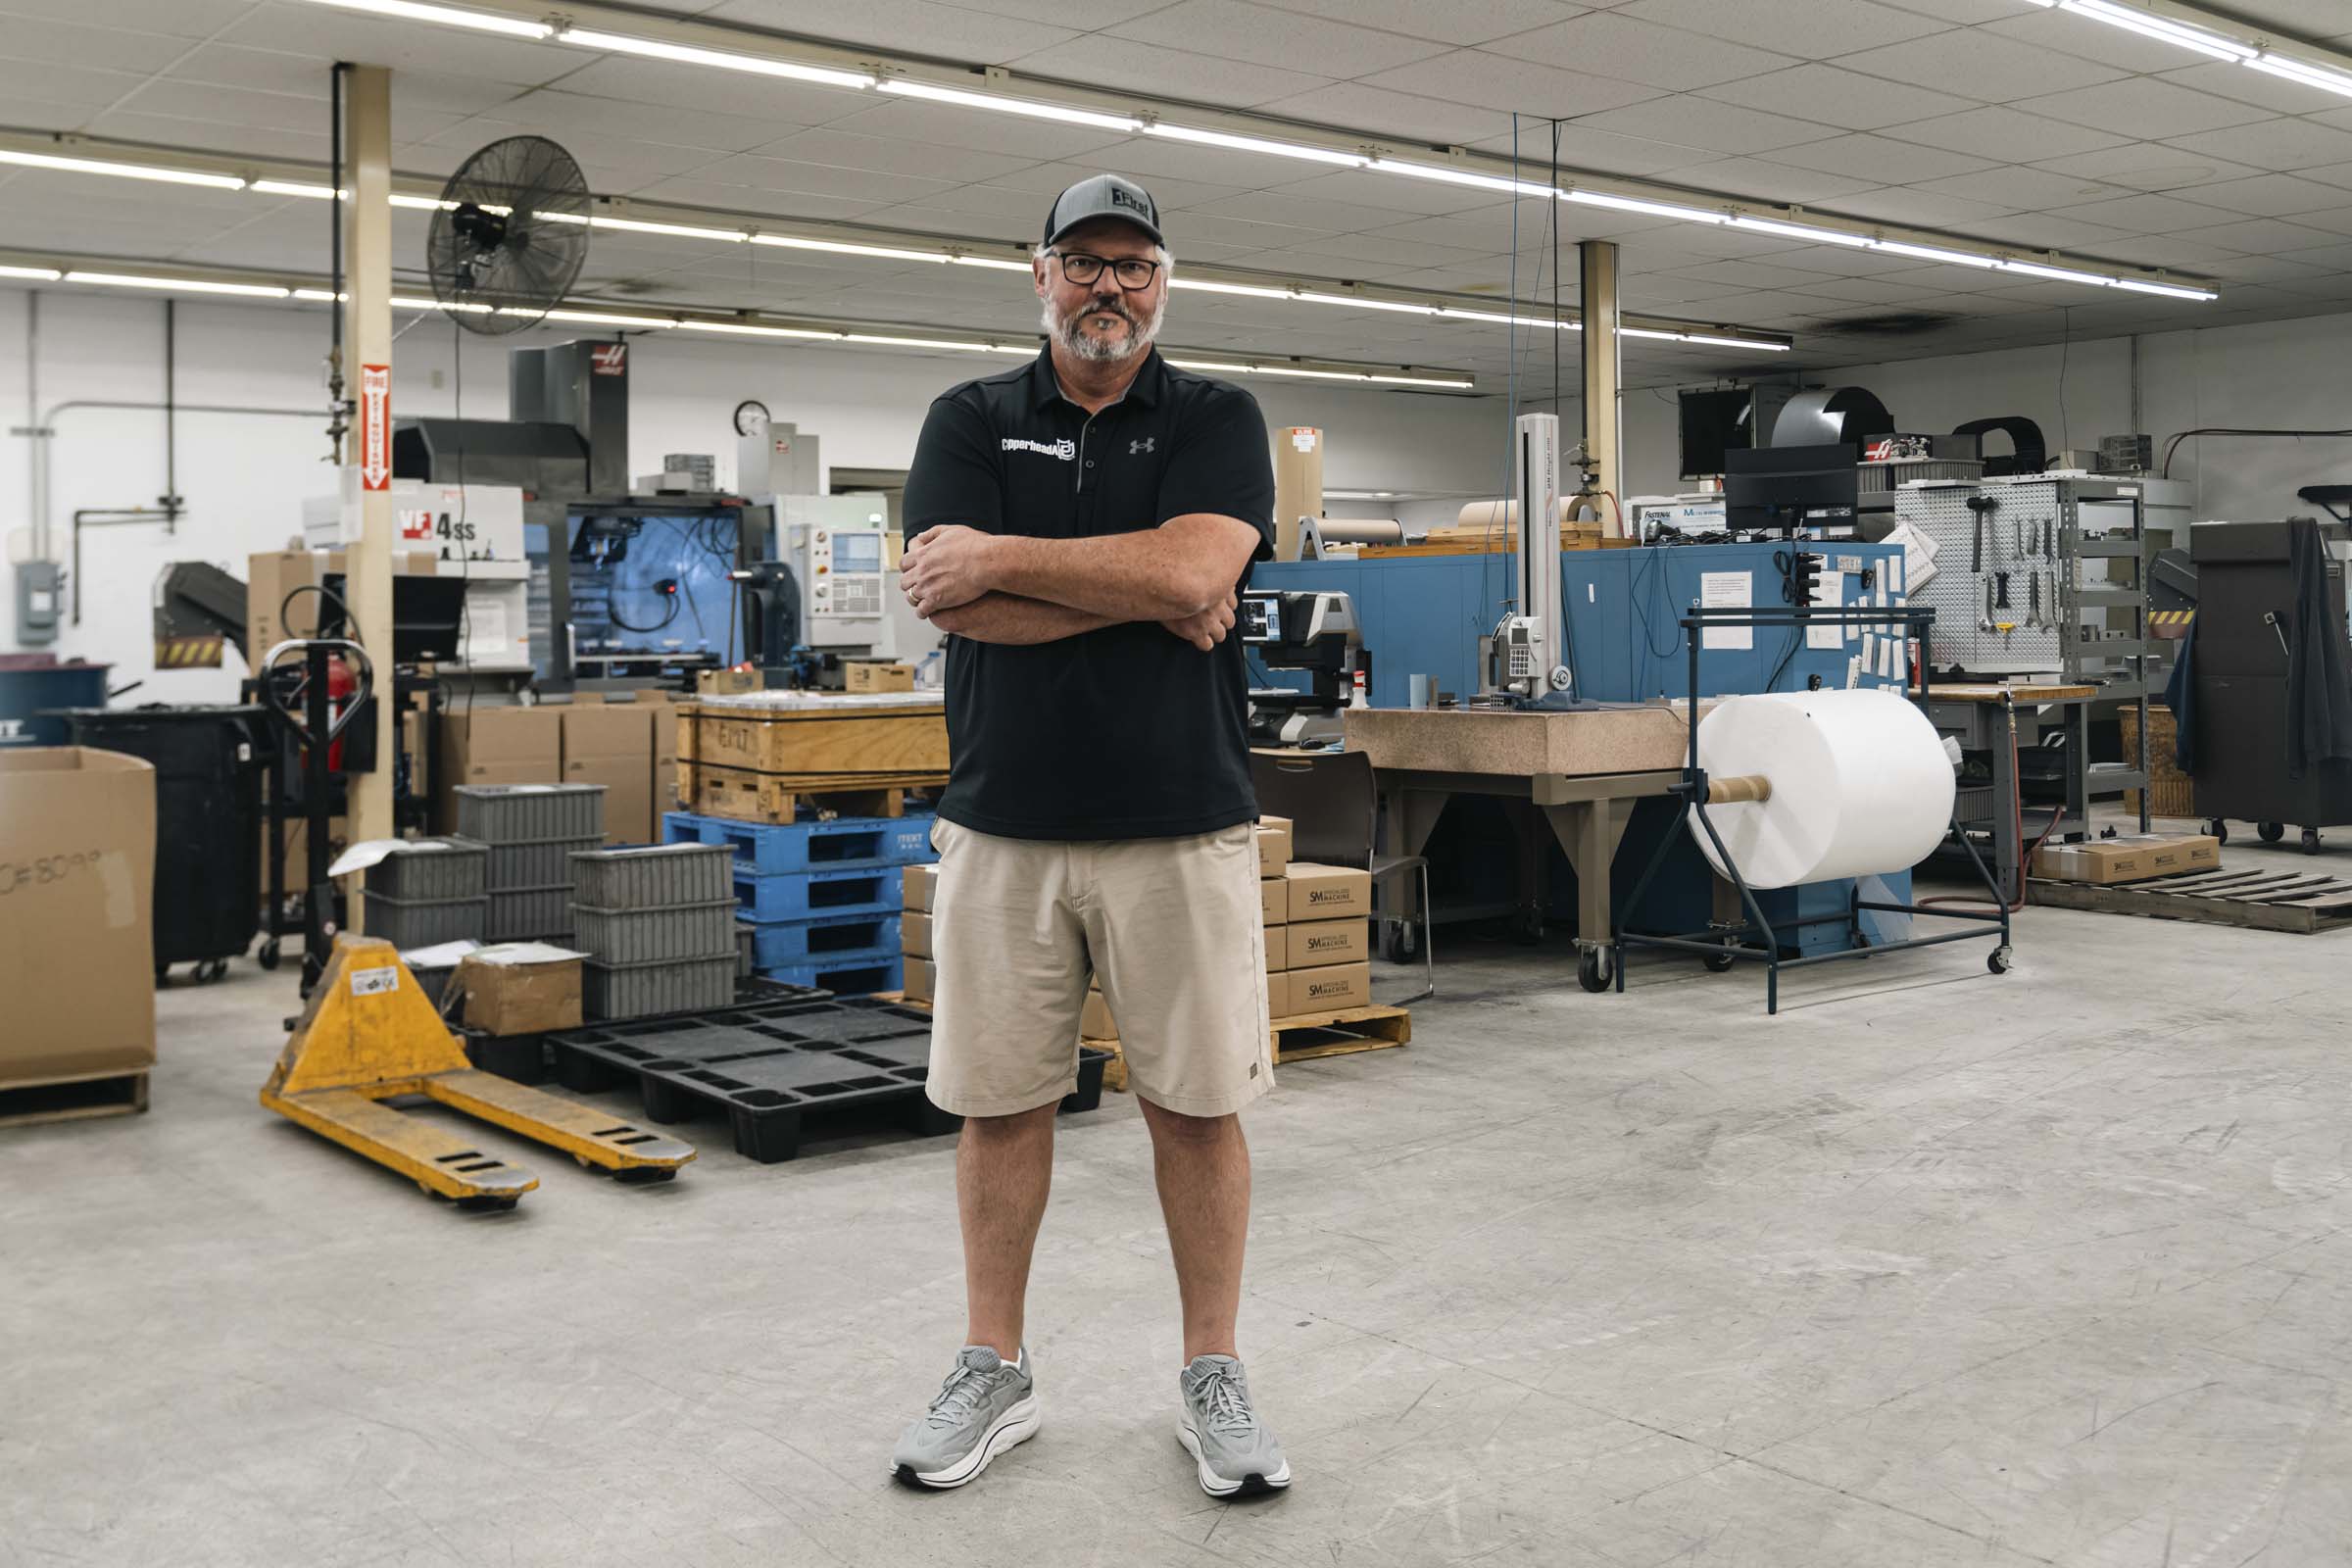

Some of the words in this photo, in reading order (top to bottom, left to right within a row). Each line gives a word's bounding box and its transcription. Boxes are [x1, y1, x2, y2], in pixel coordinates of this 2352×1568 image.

[1309, 891, 1323, 903] SM
[1307, 938, 1321, 950] SM
[1309, 984, 1323, 997] SM
